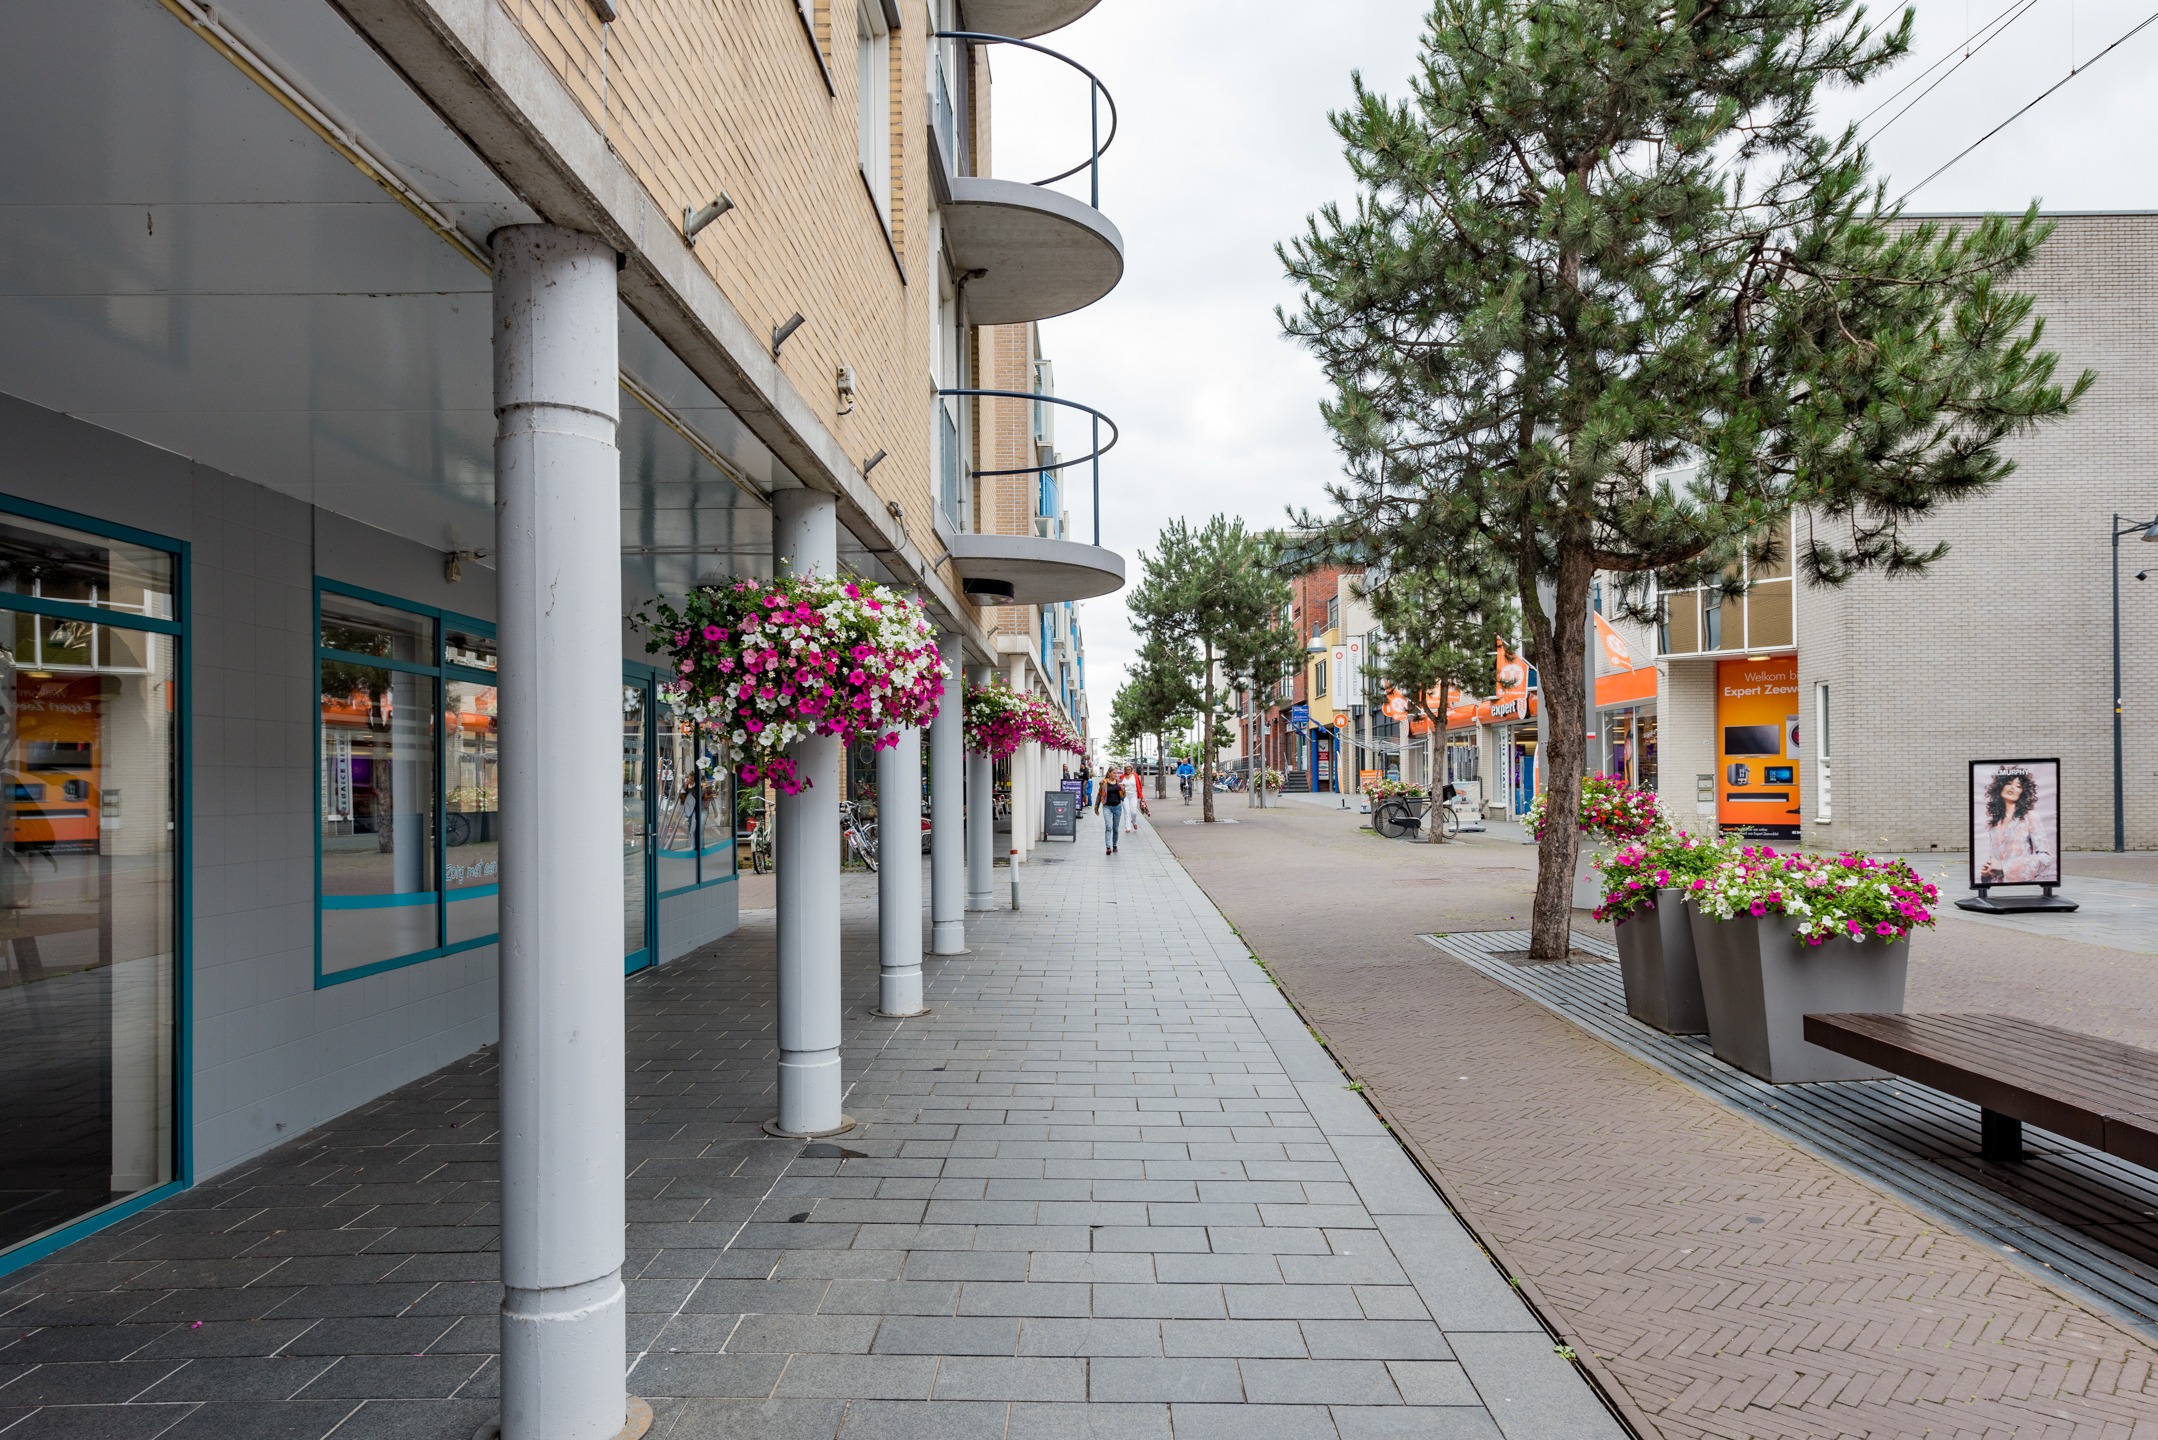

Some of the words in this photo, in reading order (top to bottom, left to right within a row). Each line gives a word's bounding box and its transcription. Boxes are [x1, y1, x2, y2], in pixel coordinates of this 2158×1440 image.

[1744, 671, 1786, 682] Welkom
[1724, 686, 1761, 698] Expert
[1764, 684, 1799, 695] Zeew
[1491, 700, 1516, 717] expert
[446, 863, 464, 884] Zorg
[467, 858, 483, 878] met
